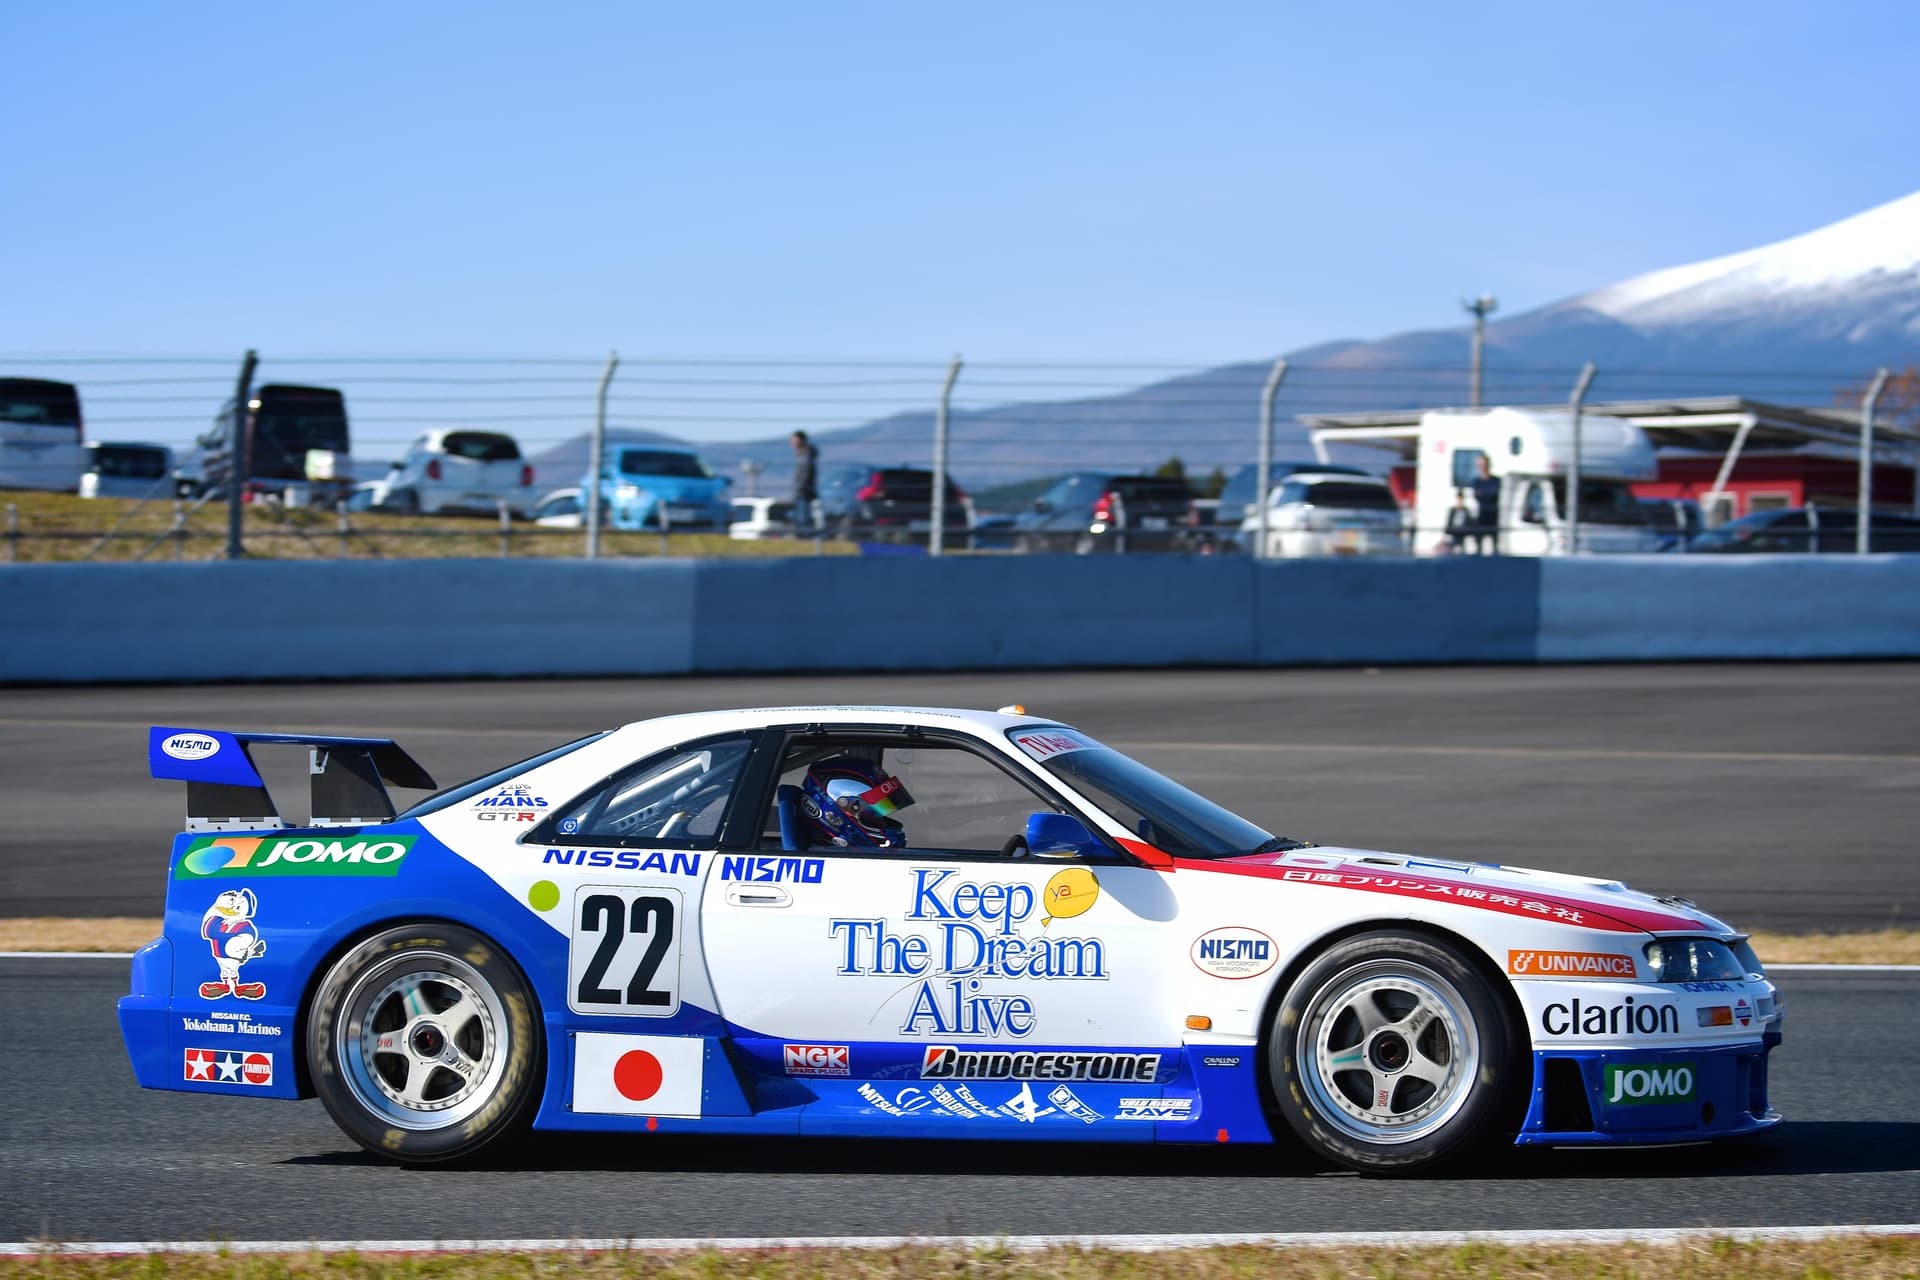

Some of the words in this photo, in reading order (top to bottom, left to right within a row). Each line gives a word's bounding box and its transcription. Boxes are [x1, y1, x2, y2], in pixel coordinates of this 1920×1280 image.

[171, 739, 213, 751] NISMO
[474, 797, 548, 806] MANS
[257, 841, 406, 867] JOMO
[543, 850, 701, 876] NISSAN
[721, 857, 825, 883] NISMO
[904, 867, 1037, 938] Keep
[1282, 870, 1584, 924] 日産プリンス販売会社
[577, 894, 674, 1006] 22
[829, 918, 933, 976] The
[937, 922, 1110, 980] Dream
[1200, 939, 1269, 960] NISMO
[1538, 955, 1633, 974] UNIVANCE
[900, 977, 1038, 1038] Alive
[1542, 996, 1679, 1035] clarion
[183, 1018, 235, 1033] Yokohama
[237, 1021, 281, 1036] Marinos
[243, 1063, 271, 1074] TAMIYA
[786, 1047, 847, 1068] NGK
[922, 1046, 1161, 1083] BRIDGESTONE
[1609, 1067, 1693, 1103] JOMO
[1117, 1107, 1191, 1116] RAYS
